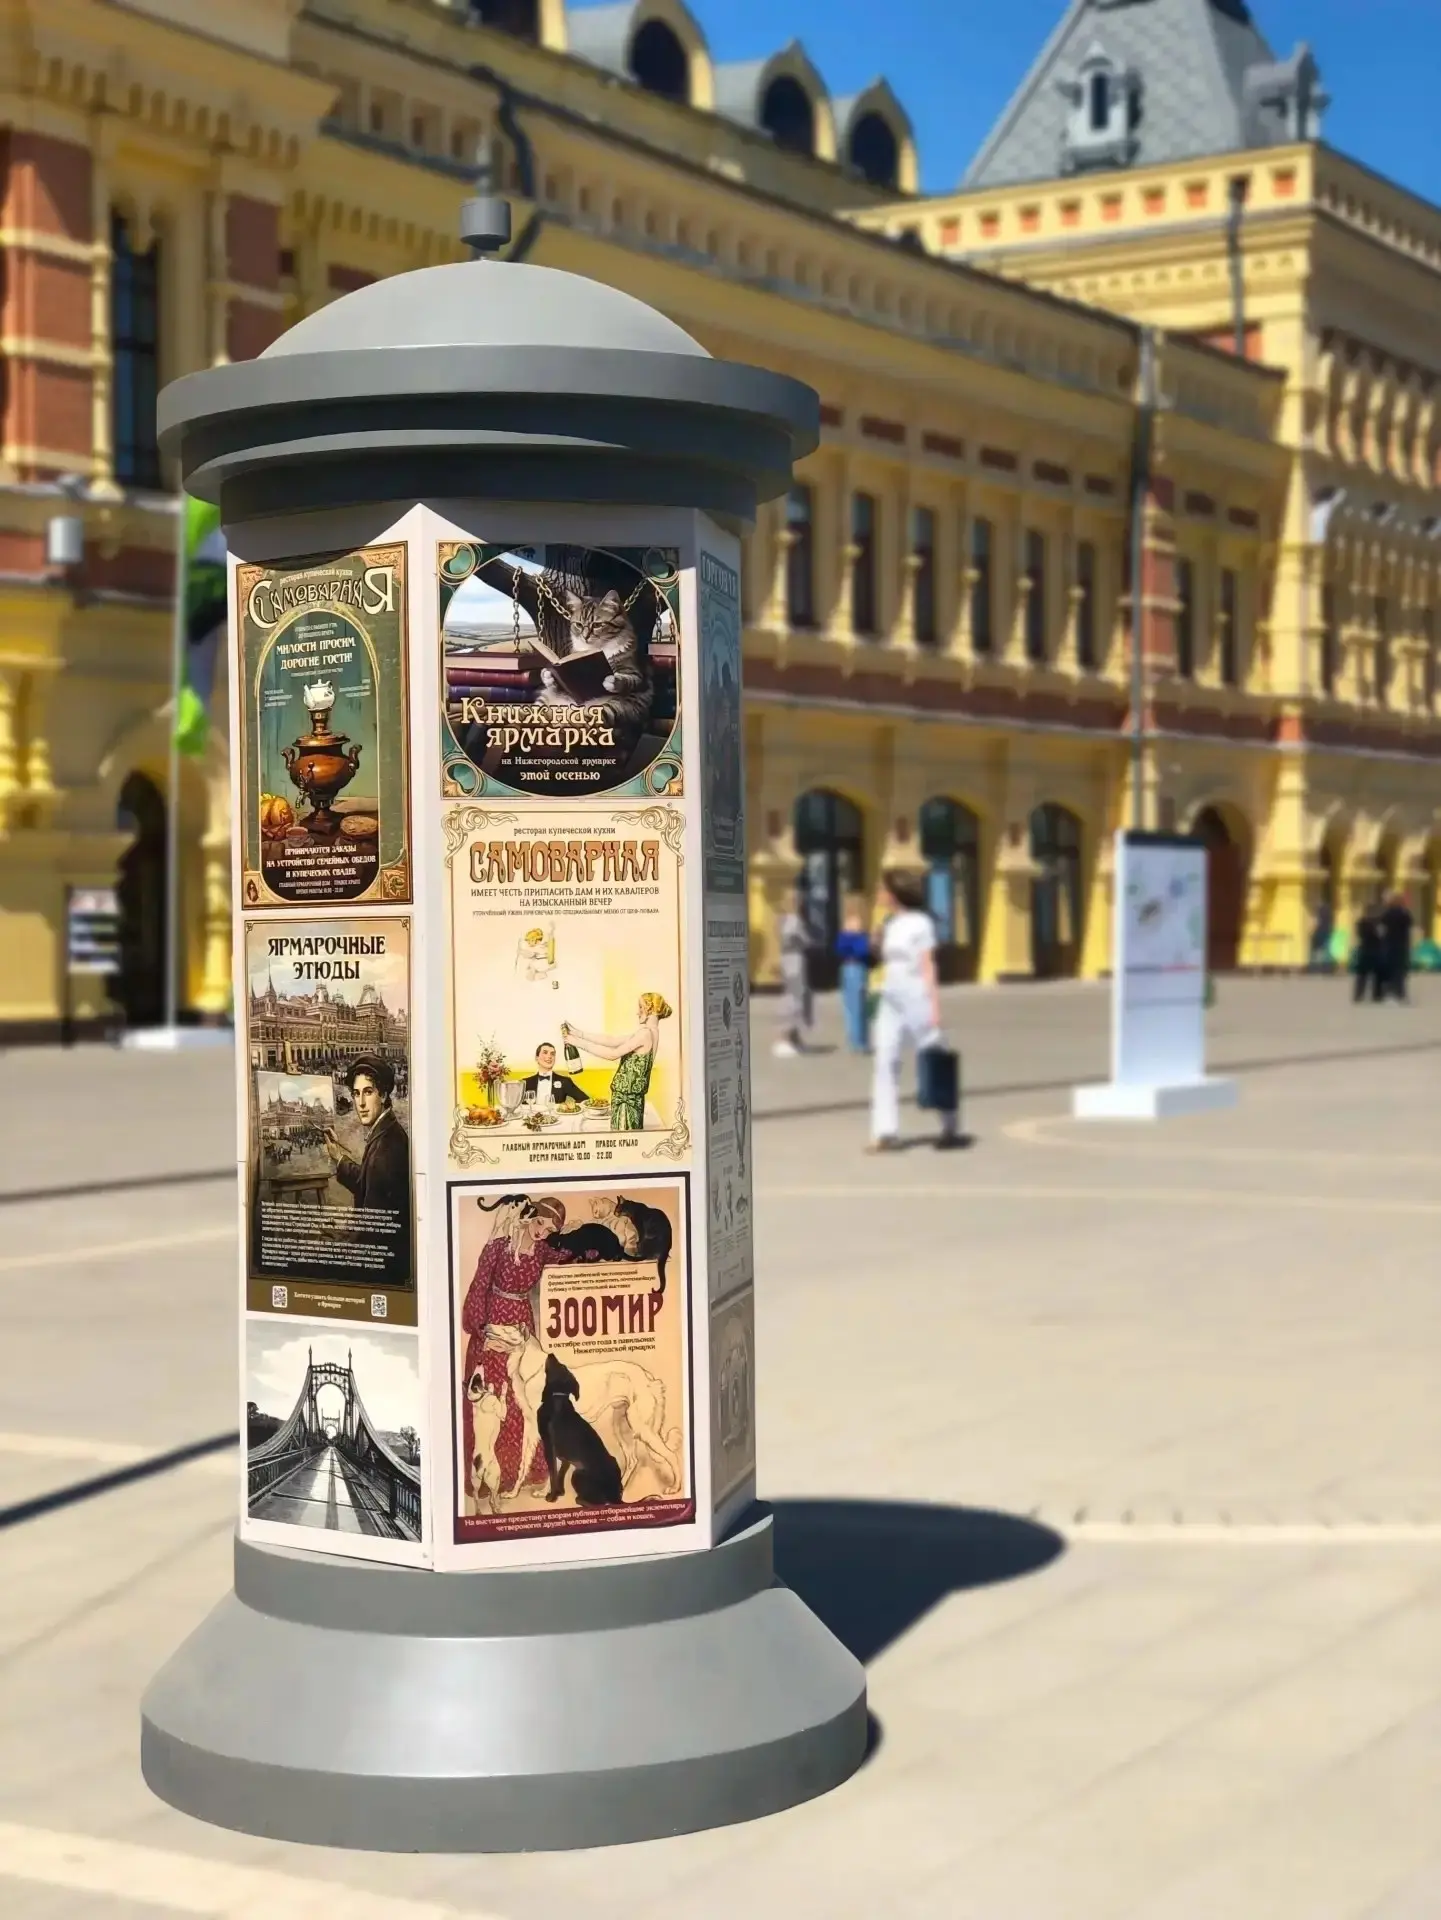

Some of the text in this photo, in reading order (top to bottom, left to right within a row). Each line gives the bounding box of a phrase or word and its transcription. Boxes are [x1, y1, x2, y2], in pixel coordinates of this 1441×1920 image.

[276, 641, 316, 655] МИЛОСТИ
[280, 652, 352, 670] ДОРОГИЕ ГОСТИ!
[460, 697, 604, 726] Книжная
[486, 726, 615, 753] ярмарка
[515, 756, 579, 767] Нижегородской
[581, 757, 616, 767] ярмарке
[520, 770, 600, 781] этой осенью
[514, 827, 616, 837] ресторан купеческой кухни
[284, 845, 357, 856] ПРИНИМАЮТСЯ ЗАКАЗЫ
[277, 858, 315, 867] УСТРОЙСТВО
[317, 856, 350, 865] СЕМЕЙНЫХ
[351, 855, 376, 863] ОБЕДОВ
[469, 840, 660, 883] САМОВАРНАЯ
[286, 868, 357, 878] И КУПЕЧЕСКИХ СВАДЕБ
[471, 886, 660, 897] ИМЕЕТ ЧЕСТЬ ПРИГЛАСИТЬ ДАМ И ИХ КАВАЛЕРОВ
[520, 897, 613, 907] НА ИЗЫСКАННЫЙ ВЕЧЕР
[268, 936, 386, 956] ЯРМАРОЧНЫЕ
[293, 961, 360, 981] ЭТЮДЫ
[502, 1138, 639, 1151] ГЛАВНЫЙ ЯРМАРОЧНЫЙ ДОМ ПРАВОЕ КРЫЛО
[529, 1154, 549, 1162] ВРЕМЯ
[551, 1153, 575, 1161] РАБОТЫ:
[596, 1151, 613, 1160] 22.00
[546, 1292, 664, 1339] ЗООМИР
[553, 1340, 581, 1349] октябре
[618, 1336, 656, 1344] павильонах
[573, 1344, 656, 1355] Нижегородской ярмарки
[475, 1517, 507, 1526] выставке
[508, 1514, 546, 1524] предстанут
[547, 1513, 571, 1522] взорам
[572, 1510, 600, 1520] публики
[600, 1506, 645, 1516] отборнейшие
[646, 1503, 686, 1512] экземпляры
[496, 1523, 541, 1532] четвероногих
[543, 1520, 566, 1529] друзей
[567, 1517, 597, 1526] человека
[607, 1514, 626, 1523] собак
